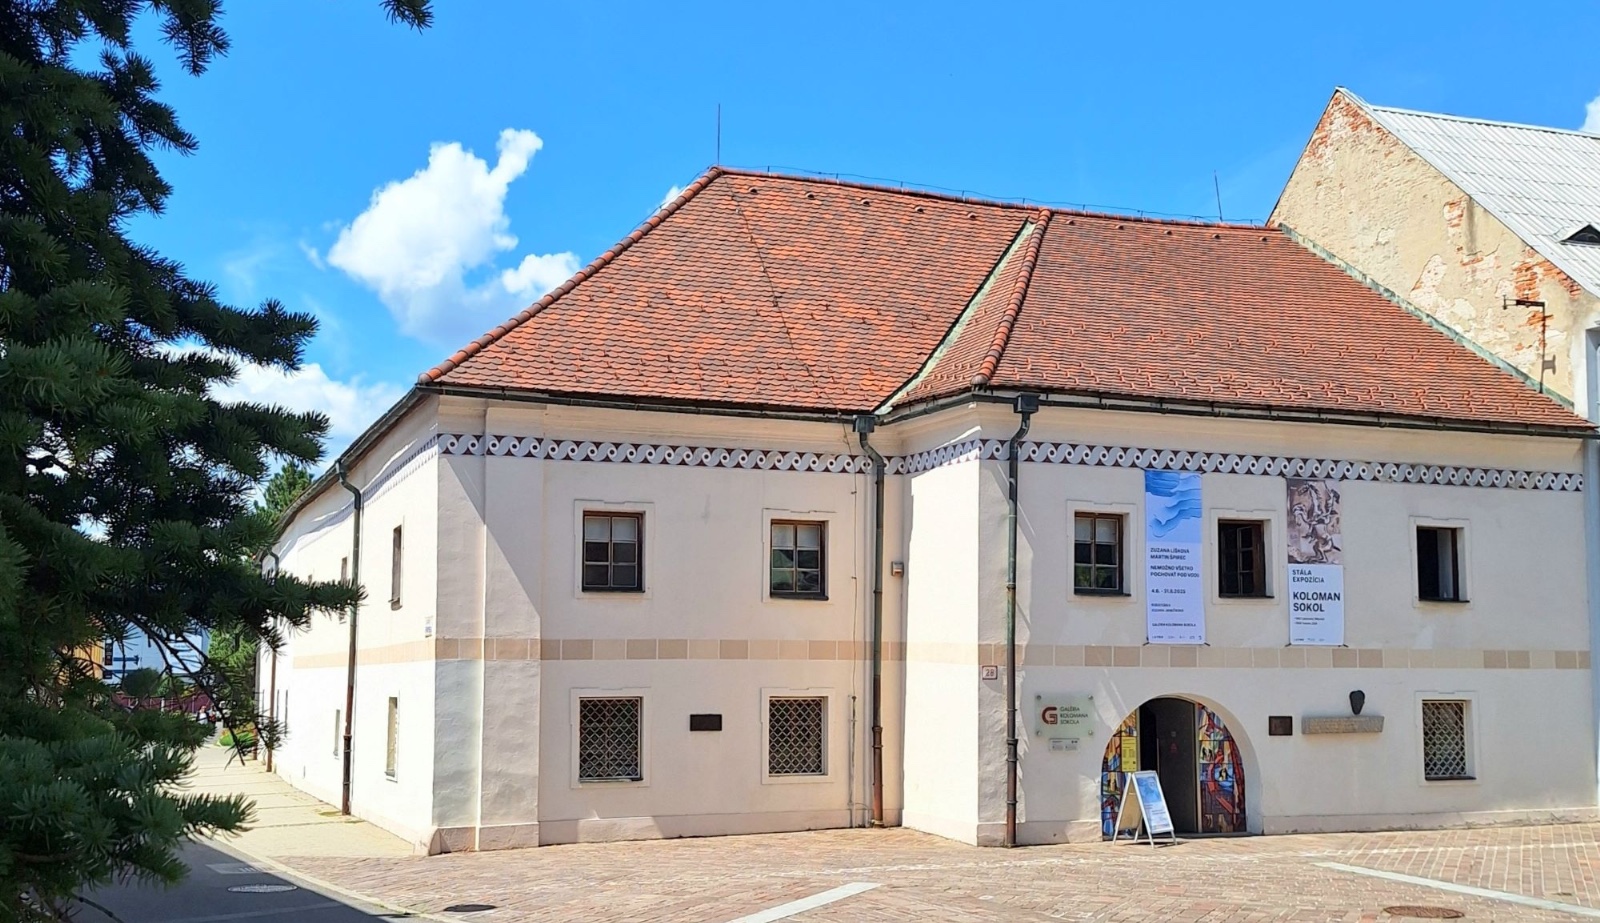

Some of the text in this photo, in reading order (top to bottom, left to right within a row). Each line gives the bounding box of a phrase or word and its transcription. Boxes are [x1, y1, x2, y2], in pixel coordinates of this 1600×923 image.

[1293, 591, 1341, 601] KOLOMAN
[1293, 602, 1325, 612] SOKOL
[985, 668, 995, 677] 28
